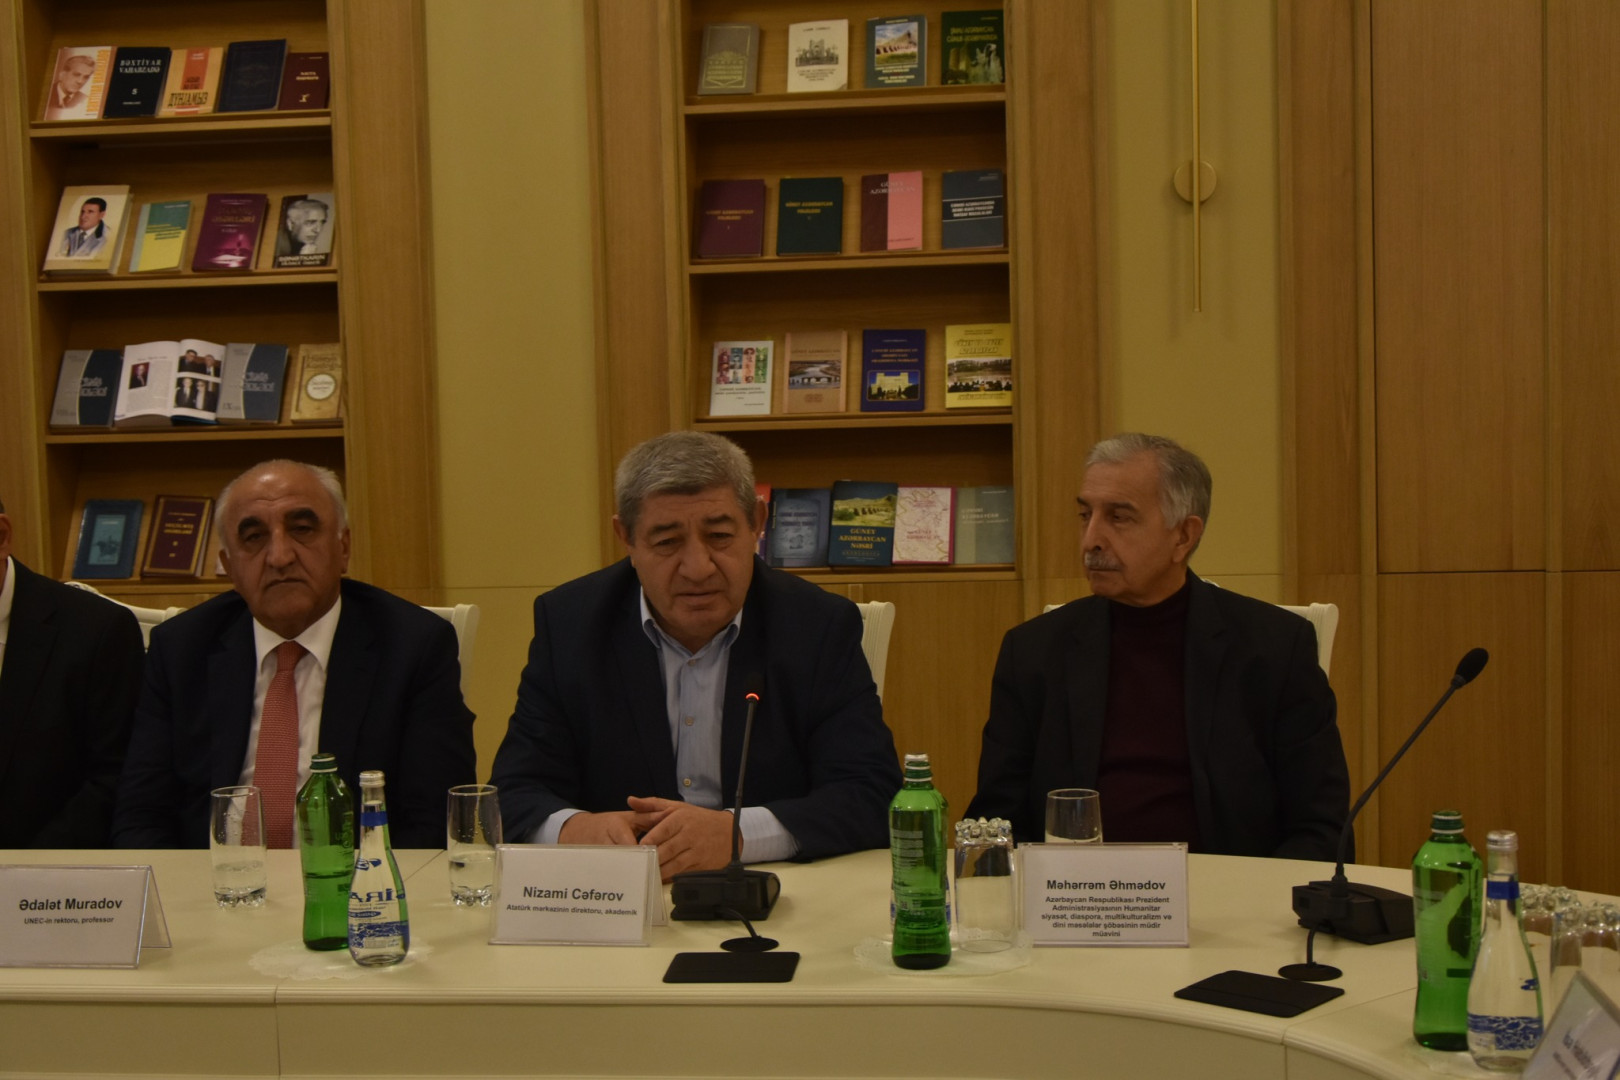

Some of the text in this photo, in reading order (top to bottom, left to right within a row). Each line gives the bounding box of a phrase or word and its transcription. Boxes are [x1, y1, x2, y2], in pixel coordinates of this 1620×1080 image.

[1047, 880, 1166, 890] Məhərrəm Əhmədov
[523, 886, 624, 901] Nizami Cəfərov
[19, 898, 123, 911] Ədalət Muradov
[1046, 897, 1087, 905] Azərbaycan
[1089, 897, 1134, 905] Respublikası
[571, 907, 603, 915] direktoru,
[1052, 905, 1121, 913] Administrasiyasının
[82, 916, 114, 925] professor
[1041, 913, 1068, 921] siyasət,
[1070, 913, 1103, 921] diaspora,
[1104, 921, 1138, 930] şöbəsinin
